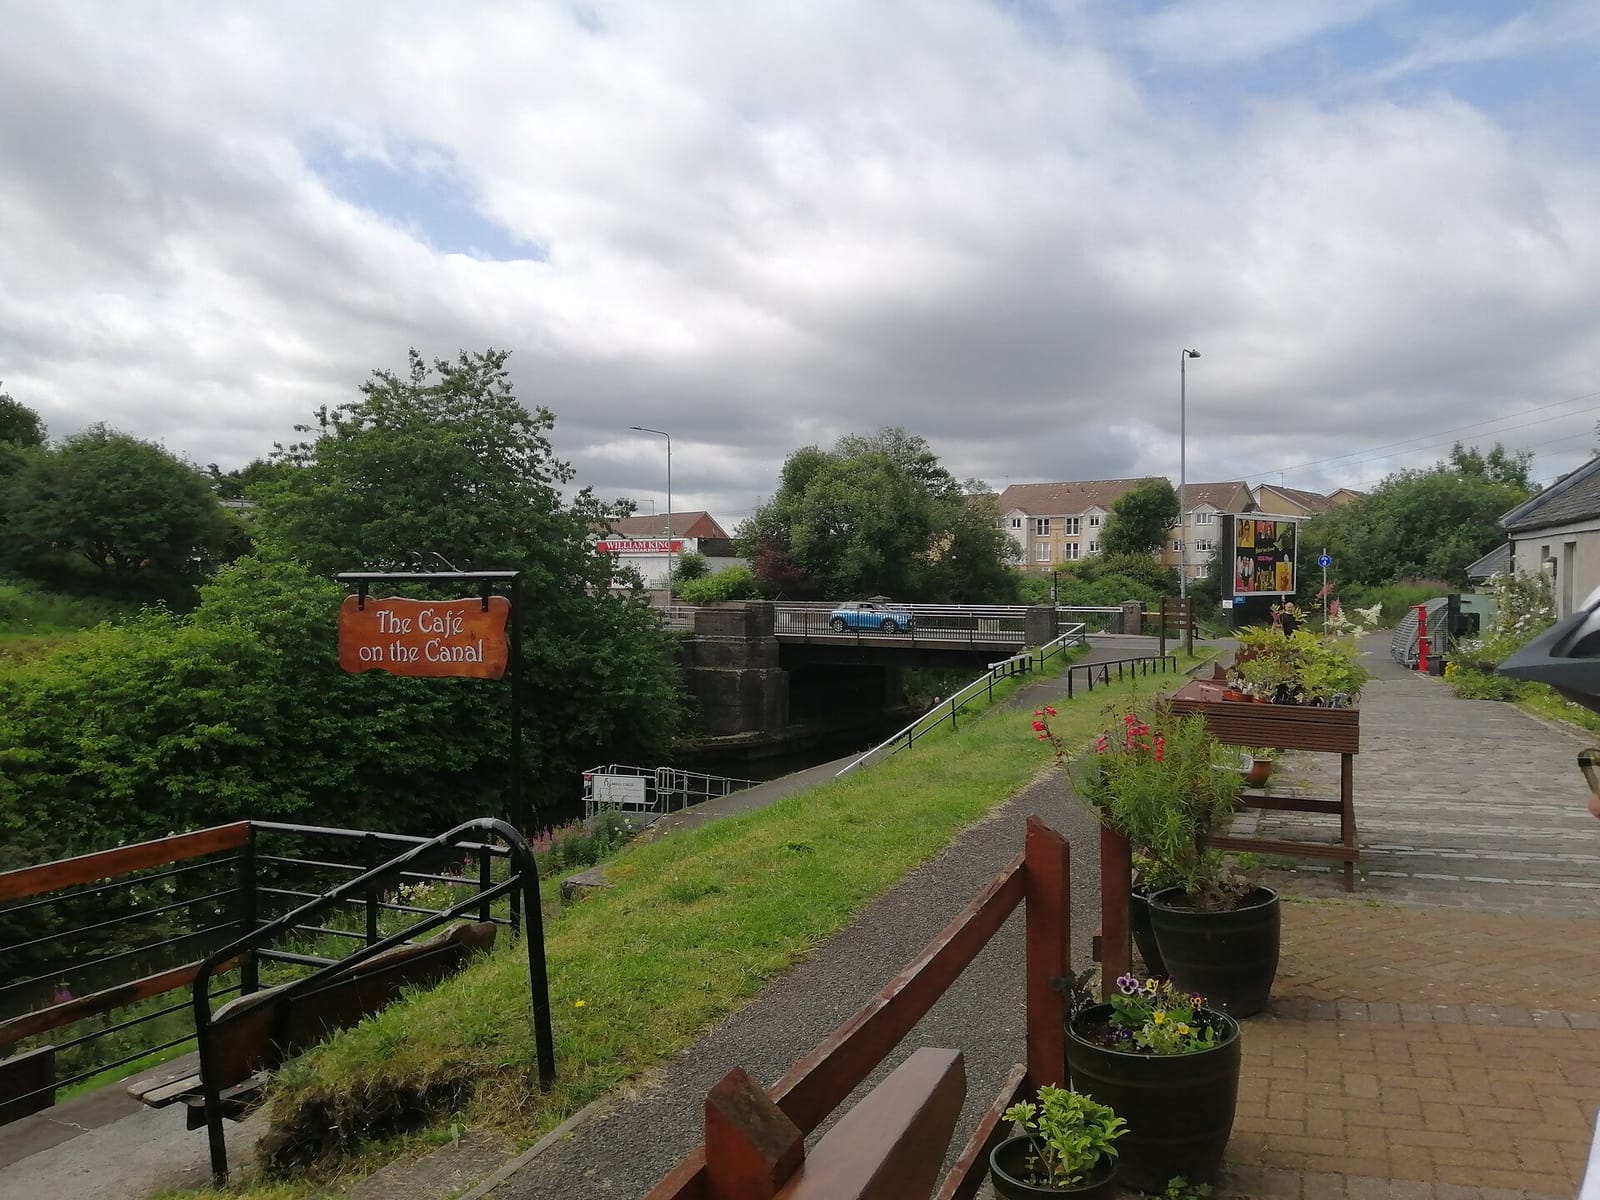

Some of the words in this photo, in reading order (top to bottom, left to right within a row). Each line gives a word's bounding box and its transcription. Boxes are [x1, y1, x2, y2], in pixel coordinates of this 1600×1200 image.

[606, 541, 646, 549] WILLIAM
[376, 609, 412, 635] The
[418, 608, 465, 638] Café
[359, 645, 384, 662] on
[389, 640, 420, 663] the
[425, 637, 484, 663] Canal
